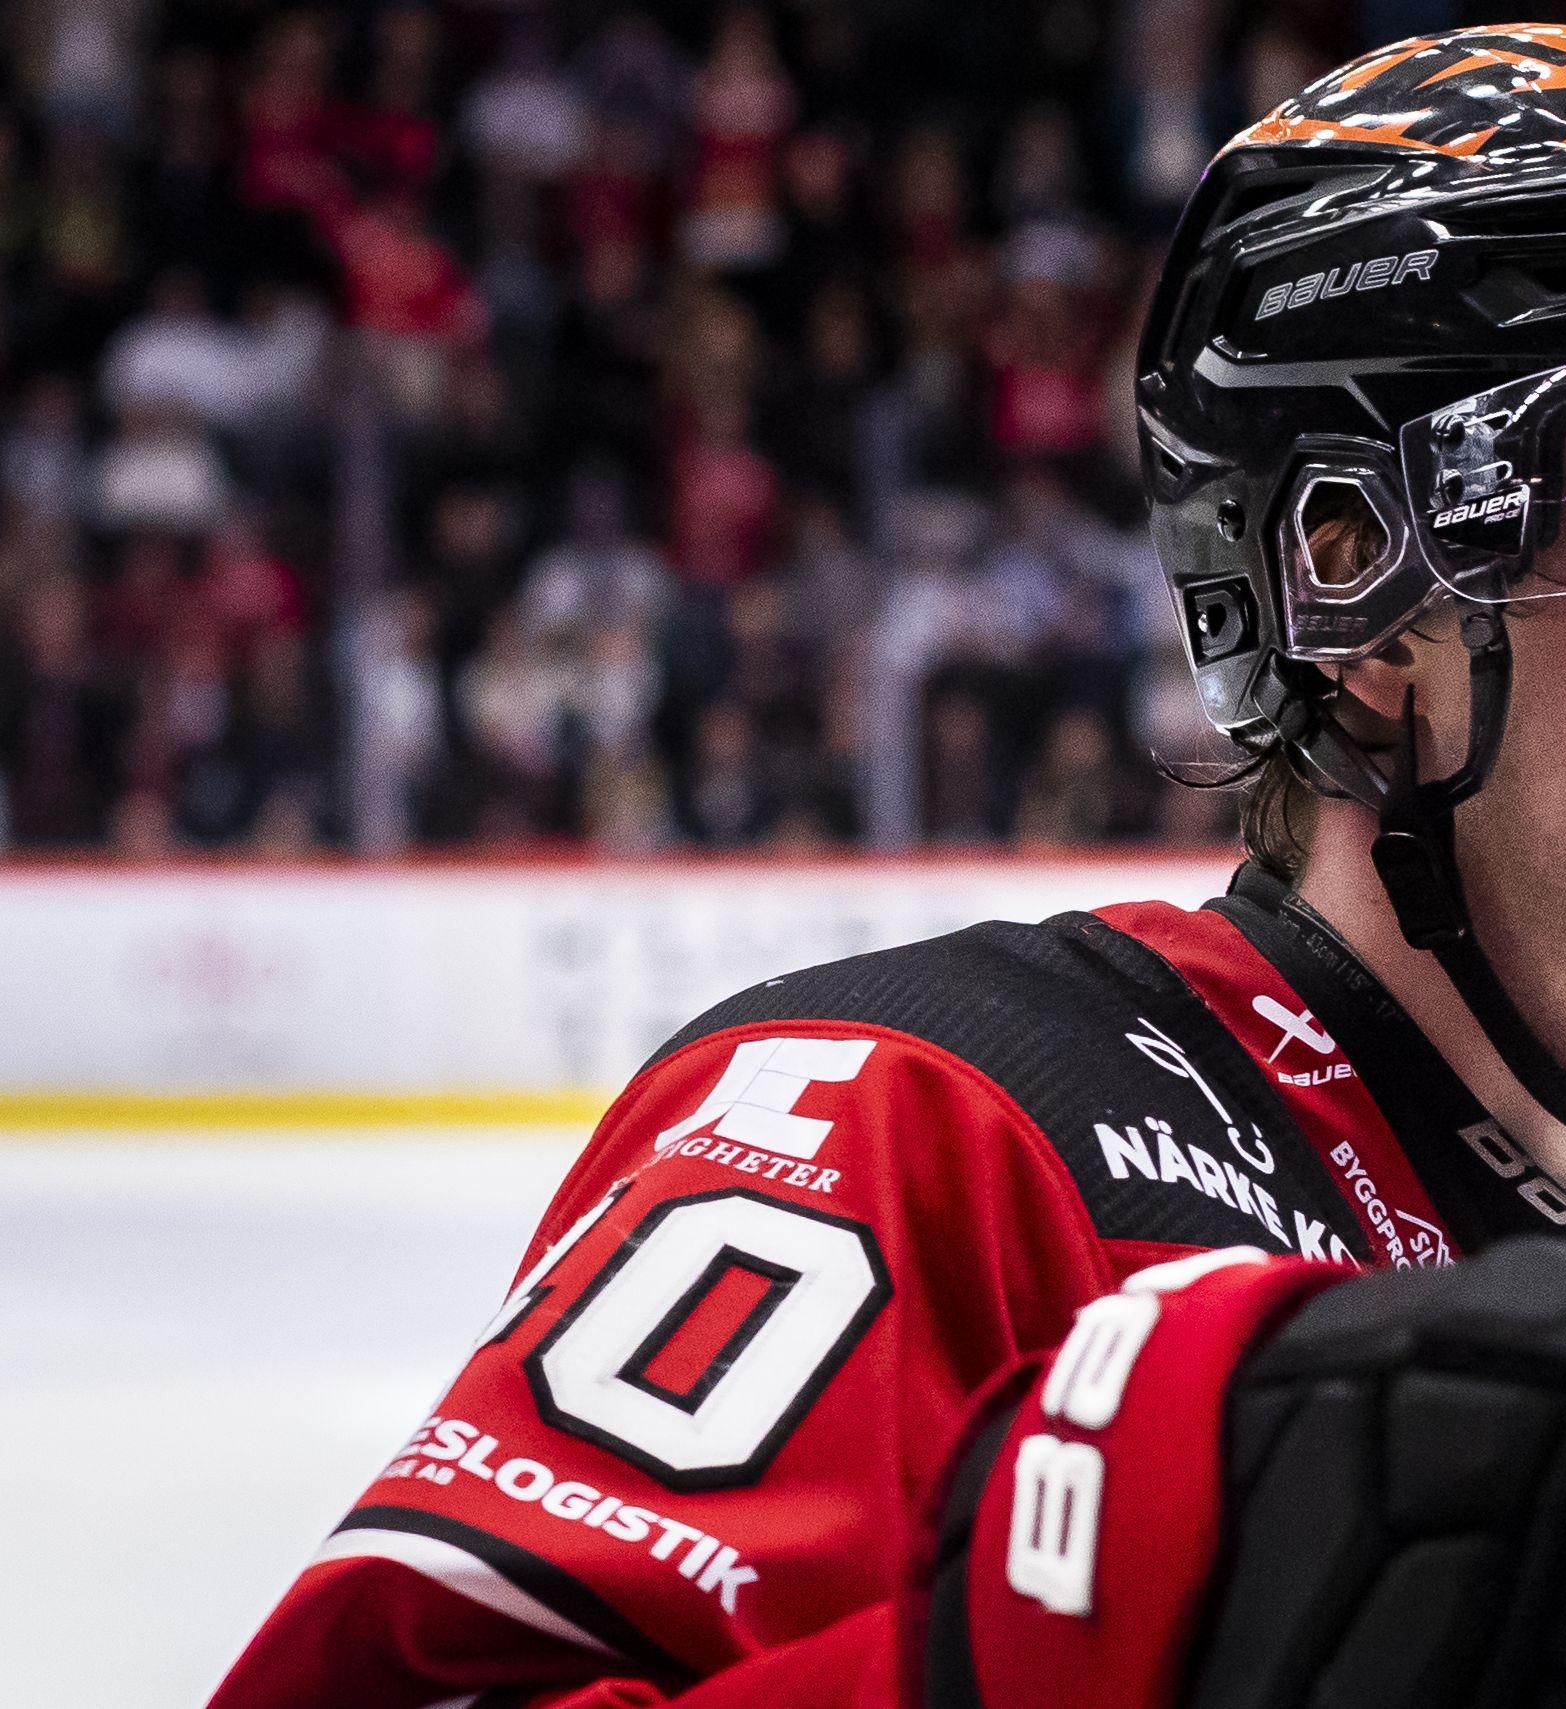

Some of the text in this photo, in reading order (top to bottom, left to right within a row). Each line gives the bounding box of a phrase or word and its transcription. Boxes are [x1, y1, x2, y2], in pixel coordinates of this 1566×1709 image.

[1255, 249, 1439, 321] BAUER
[1433, 490, 1522, 528] BAUER
[1277, 1063, 1358, 1087] BAUE
[1094, 1116, 1292, 1250] NÄRKE
